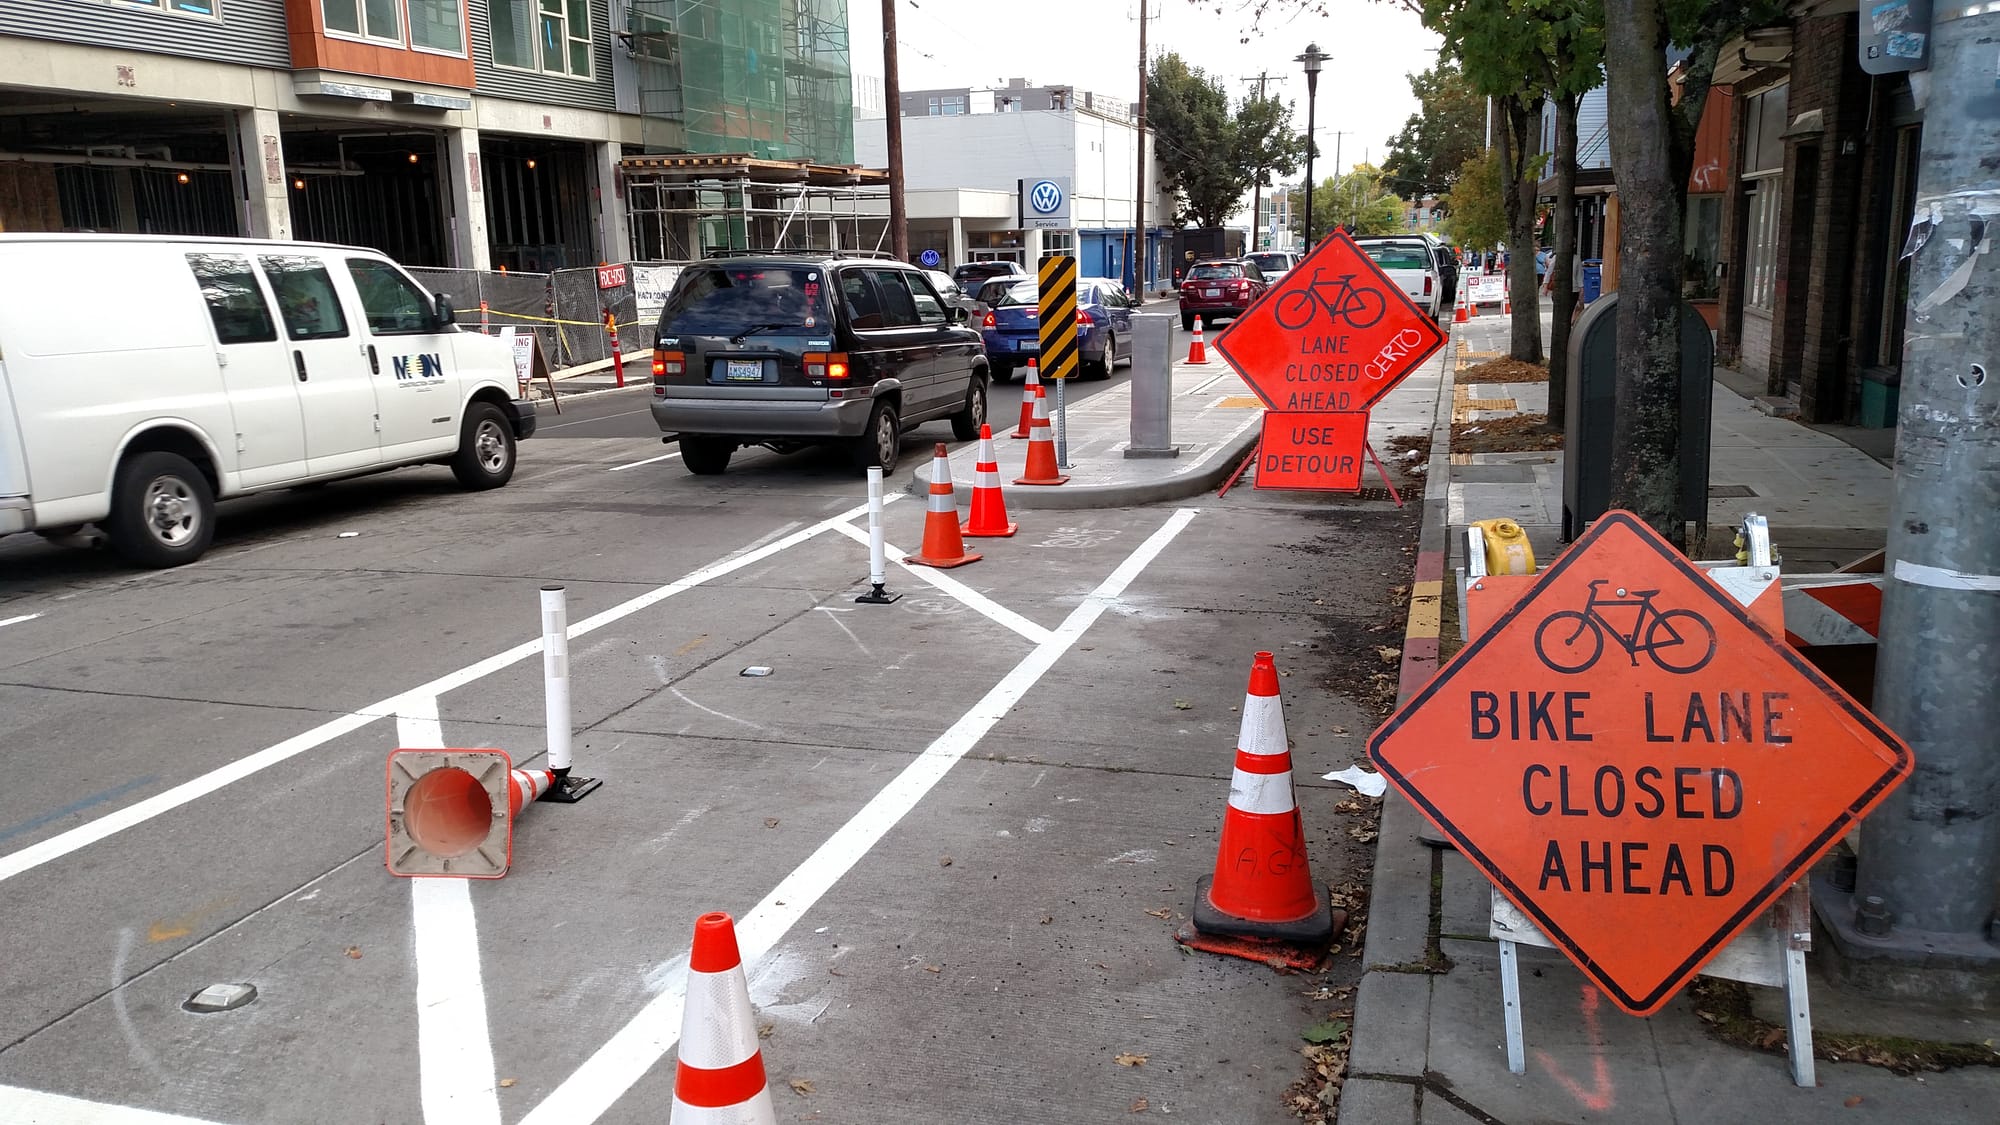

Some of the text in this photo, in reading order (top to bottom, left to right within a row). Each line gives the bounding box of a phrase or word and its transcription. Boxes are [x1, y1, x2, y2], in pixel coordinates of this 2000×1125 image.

[1301, 335, 1350, 354] LANE
[1364, 328, 1422, 380] CERTO
[1286, 364, 1359, 382] CLOSED
[1287, 391, 1351, 410] AHEAD
[1292, 427, 1335, 446] USE
[1265, 454, 1354, 474] DETOUR
[1470, 690, 1793, 744] BIKE LANE
[1522, 763, 1744, 819] CLOSED
[1538, 839, 1736, 897] AHEAD
